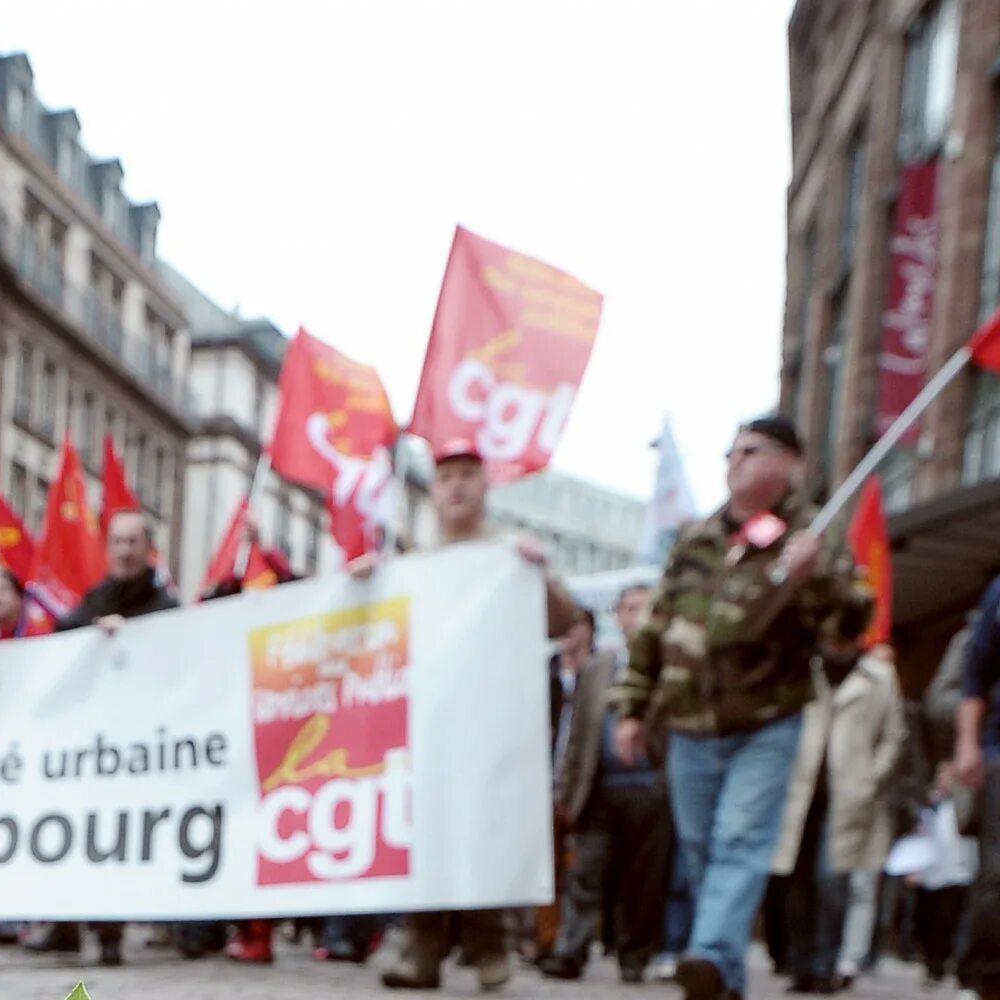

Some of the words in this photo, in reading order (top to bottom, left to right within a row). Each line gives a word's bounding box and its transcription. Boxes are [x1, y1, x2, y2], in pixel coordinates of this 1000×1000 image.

[448, 358, 580, 461] cgt
[42, 727, 228, 780] urbaine
[257, 747, 416, 881] cgt
